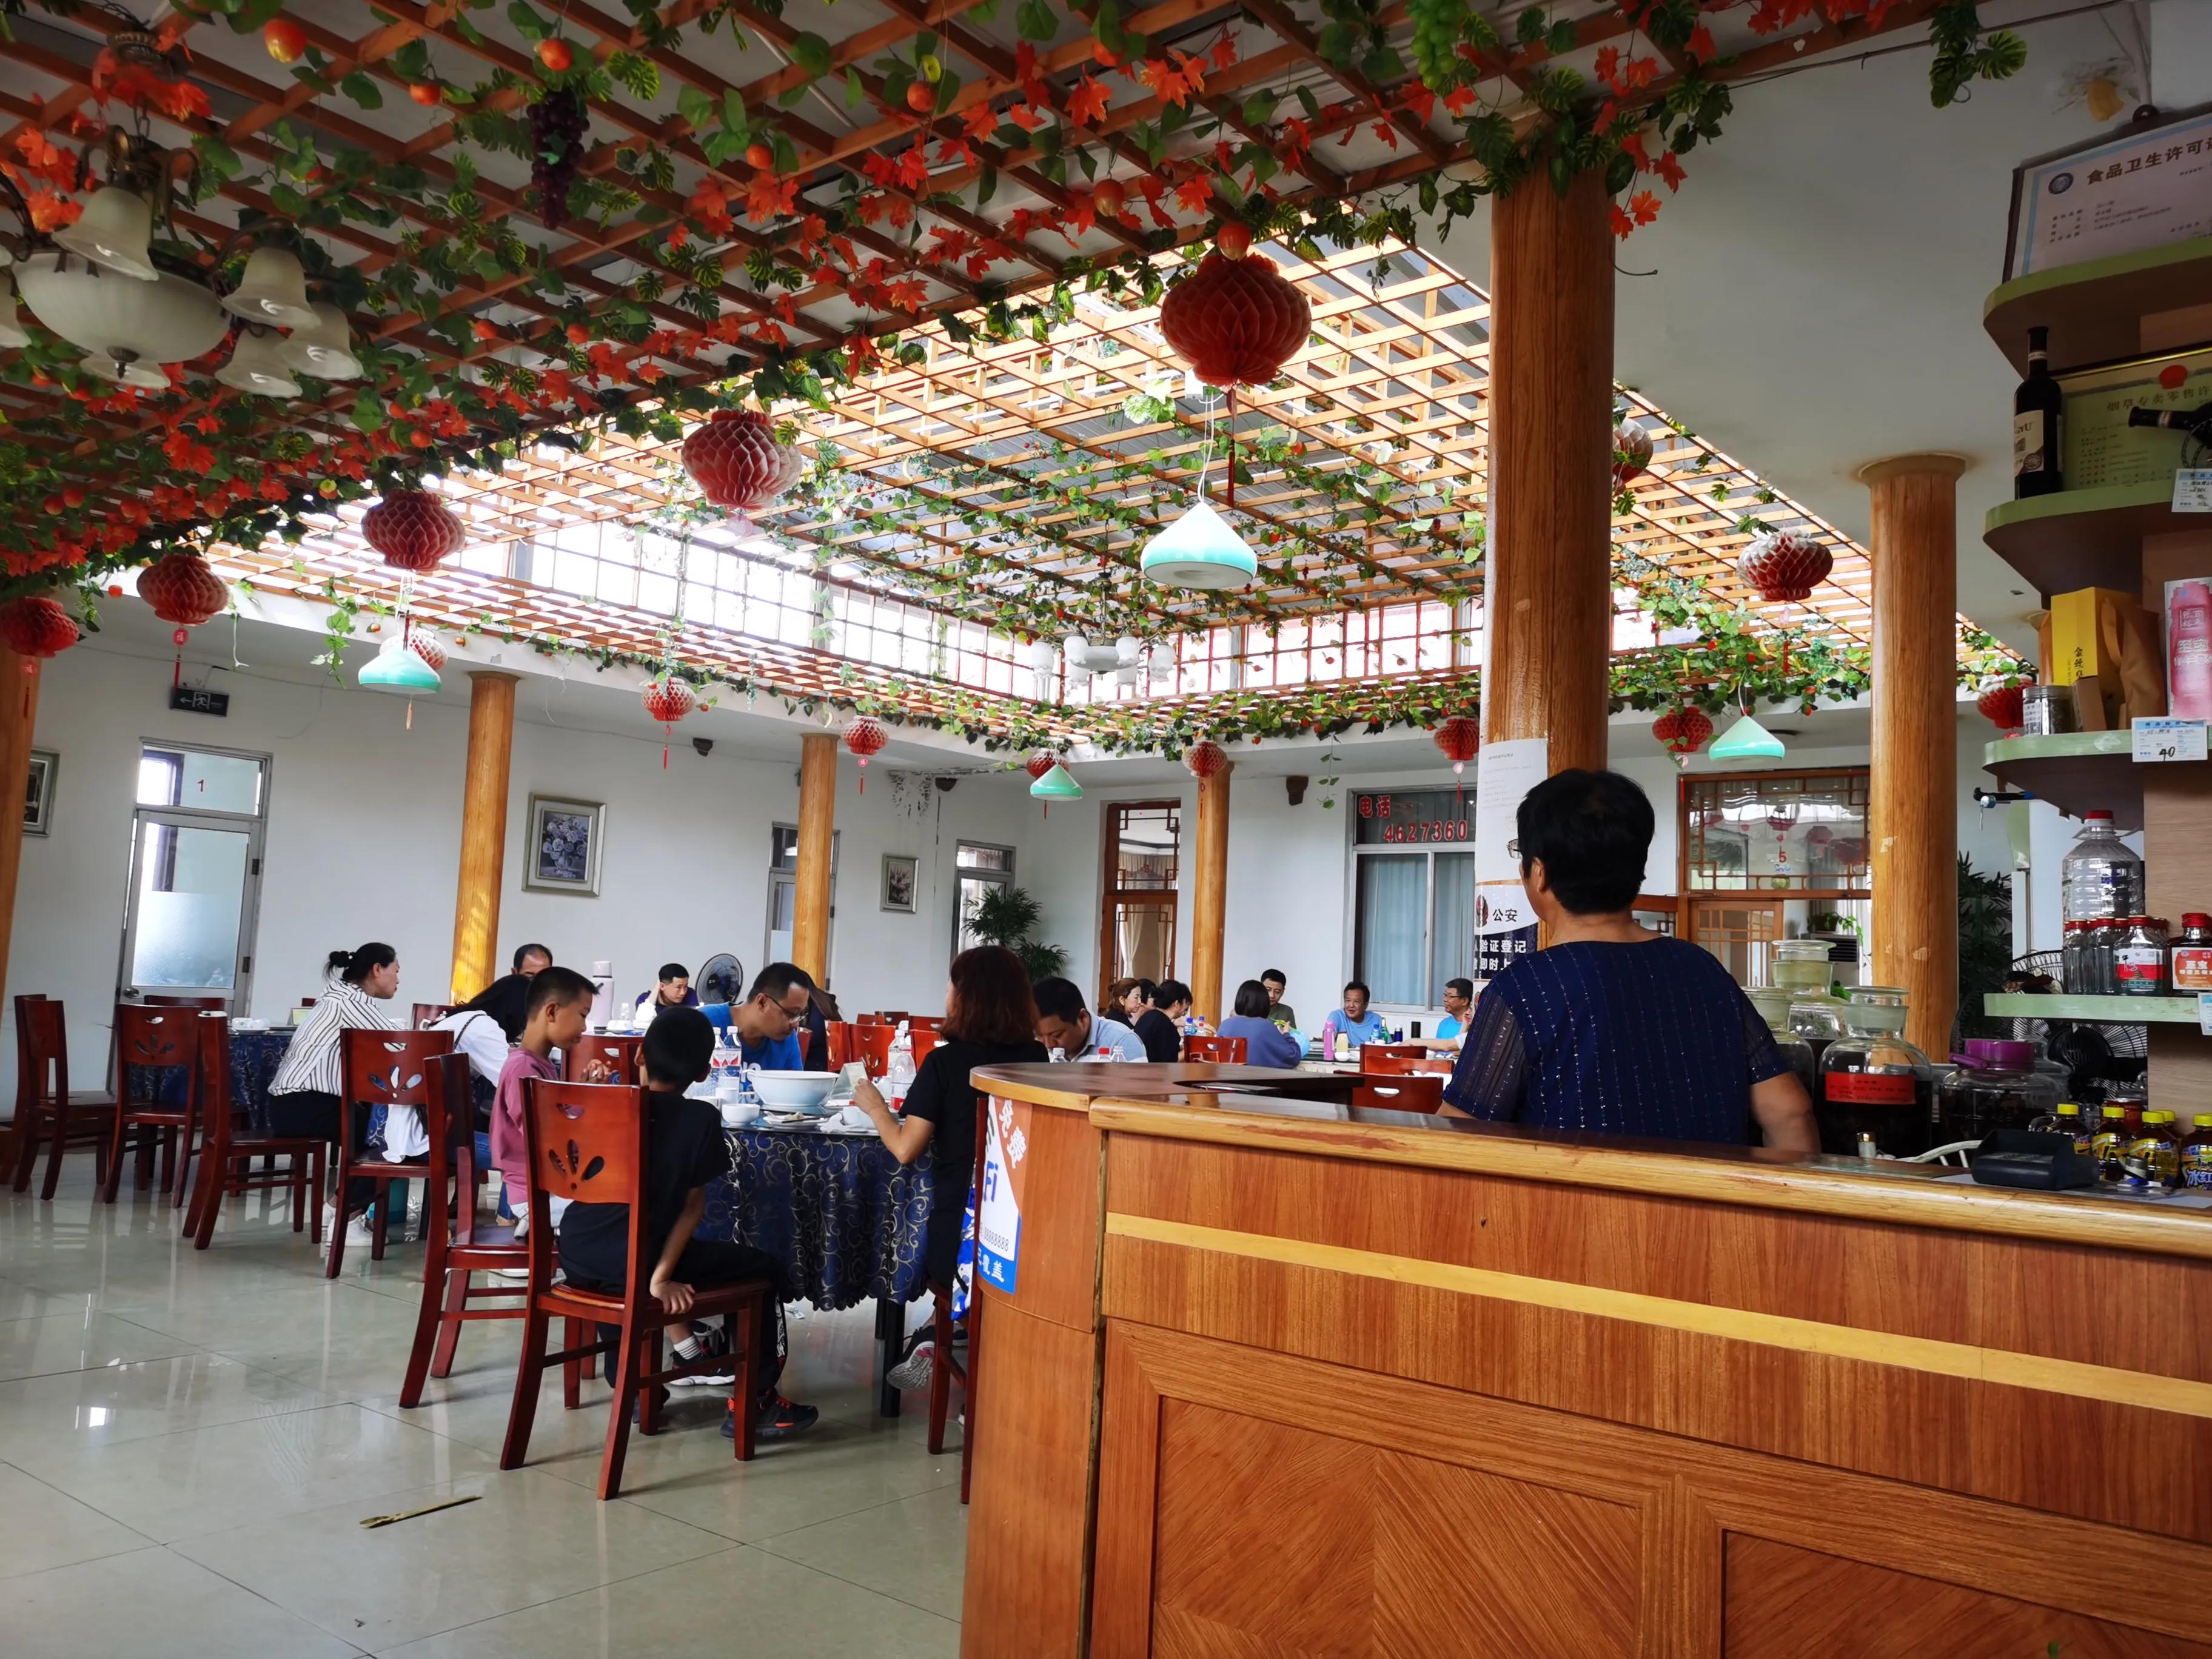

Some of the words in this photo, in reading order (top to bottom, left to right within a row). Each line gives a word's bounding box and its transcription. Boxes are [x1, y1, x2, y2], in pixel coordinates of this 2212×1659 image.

[2159, 746, 2176, 762] 40
[197, 779, 204, 792] 1
[1358, 795, 1391, 819] 电话
[1383, 819, 1468, 843] 4627360
[1778, 851, 1787, 863] 5
[1492, 908, 1518, 922] 公安
